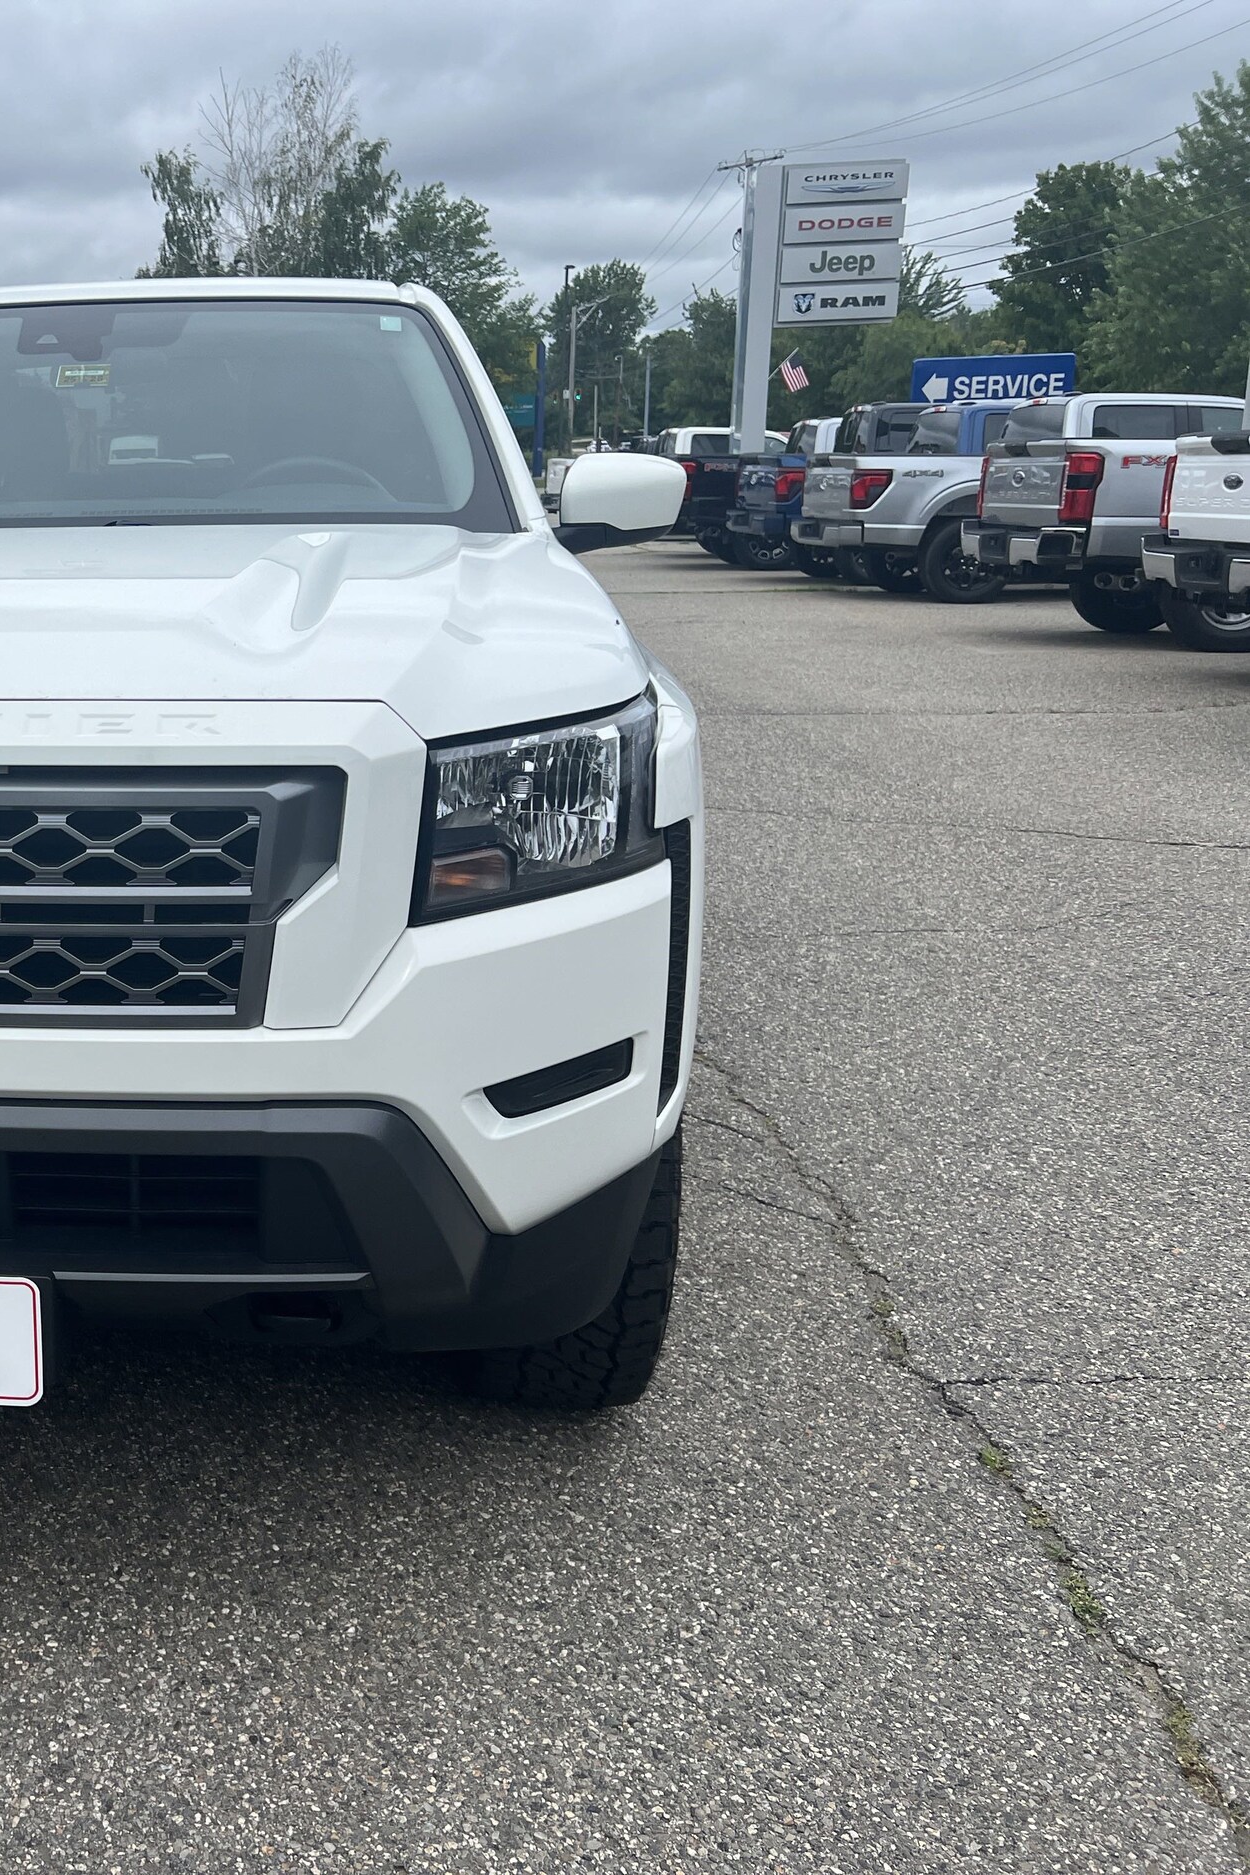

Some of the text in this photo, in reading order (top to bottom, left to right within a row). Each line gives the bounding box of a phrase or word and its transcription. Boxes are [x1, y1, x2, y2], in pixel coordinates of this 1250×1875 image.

[804, 171, 895, 182] CHRYSLER
[798, 216, 893, 231] DODGE
[809, 251, 875, 276] Jeep
[820, 296, 886, 309] RAM
[953, 373, 1065, 399] SERVICE
